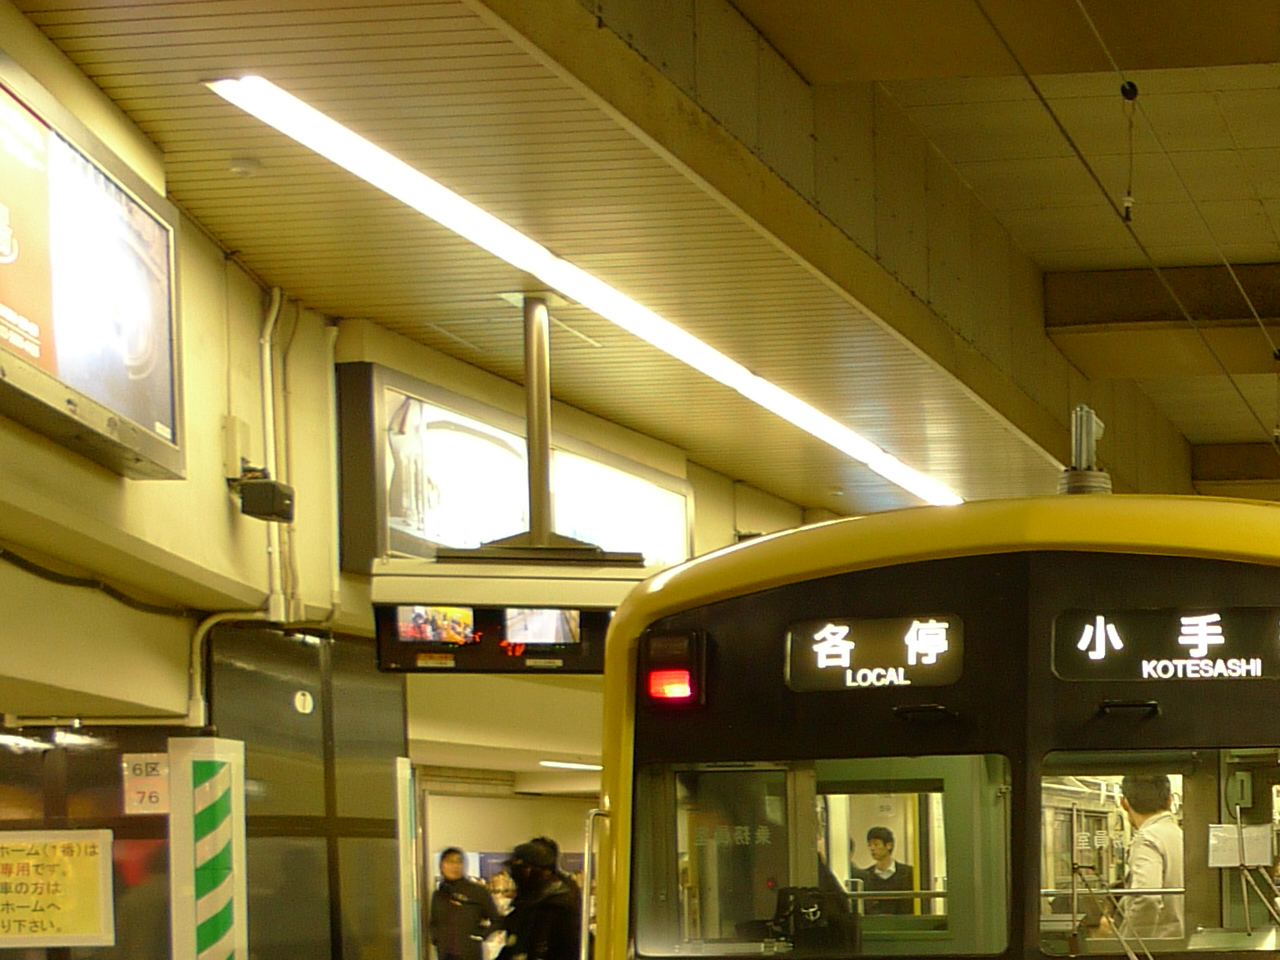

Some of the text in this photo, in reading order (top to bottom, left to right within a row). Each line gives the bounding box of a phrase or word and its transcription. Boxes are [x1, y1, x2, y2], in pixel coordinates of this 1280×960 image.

[812, 619, 950, 669] 各停
[846, 667, 911, 686] LOCAL
[1141, 658, 1262, 678] KOTESASHI
[132, 762, 160, 777] 6区
[136, 791, 160, 804] 76
[1, 900, 61, 914] ホームへ
